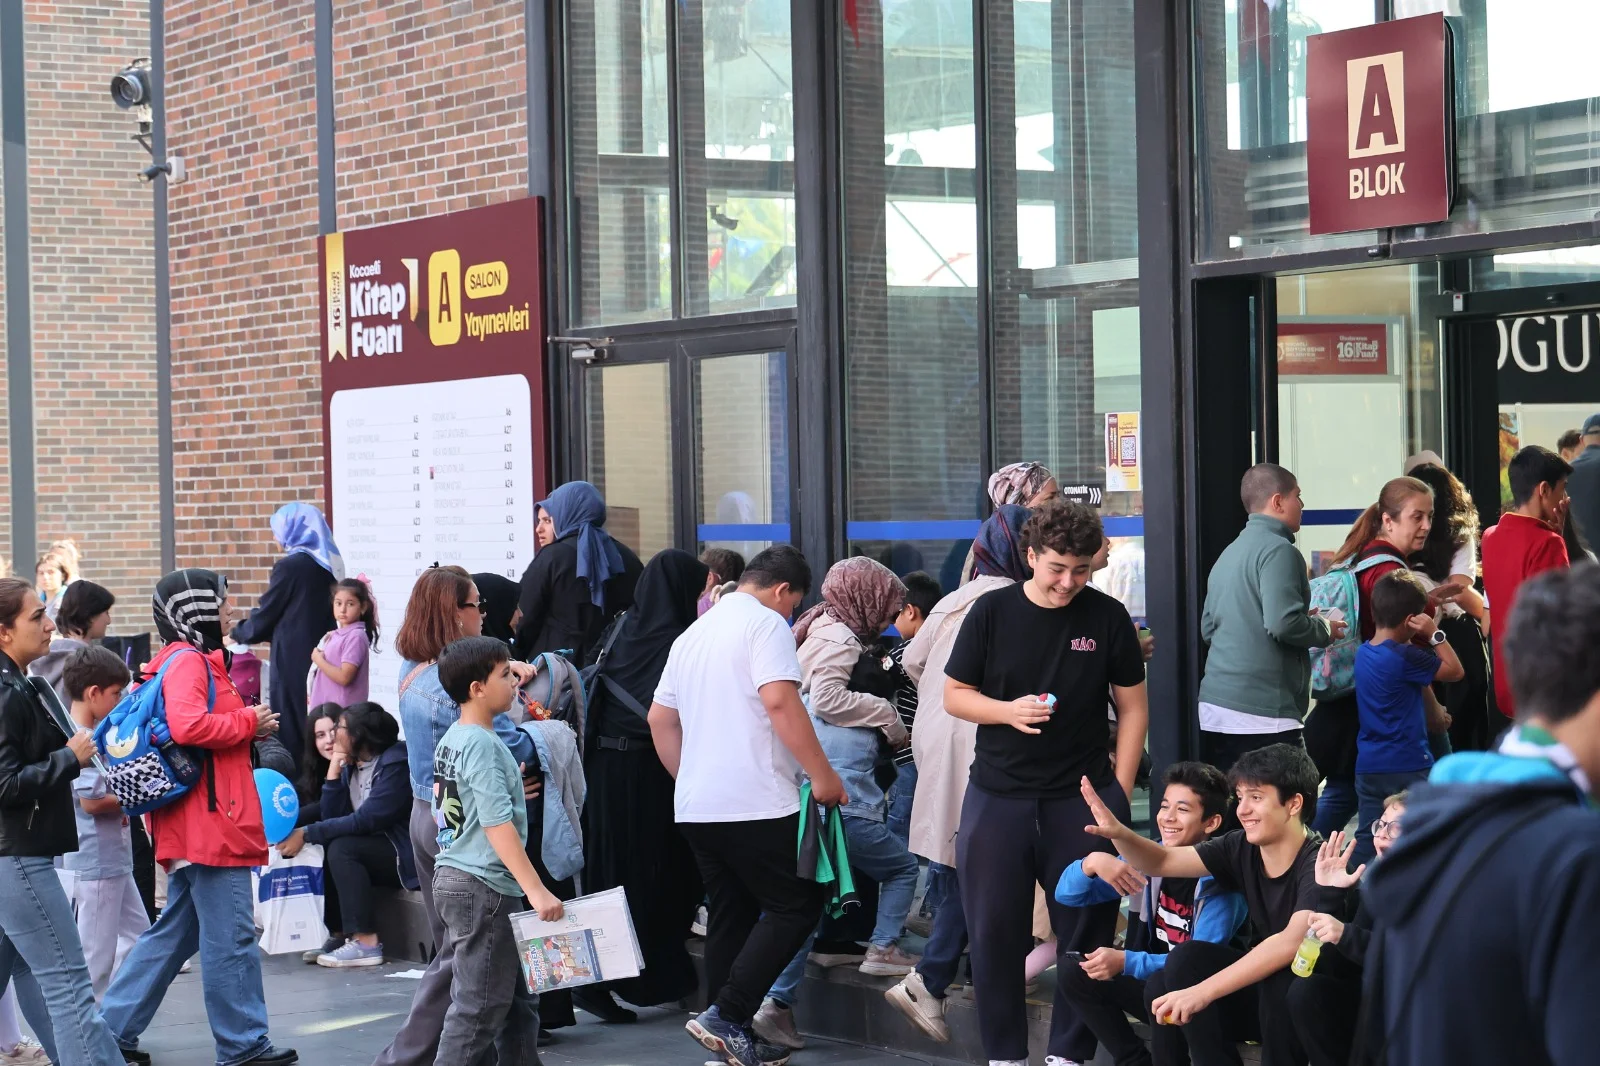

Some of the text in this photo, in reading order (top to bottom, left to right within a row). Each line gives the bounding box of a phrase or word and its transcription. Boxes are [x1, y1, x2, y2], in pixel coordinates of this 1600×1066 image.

[1355, 63, 1399, 151] A
[1349, 163, 1405, 200] BLOK
[350, 260, 381, 279] Kocaeli
[470, 270, 501, 289] SALON
[350, 280, 406, 320] Kitap
[438, 271, 451, 324] A
[351, 322, 403, 358] Fuarı
[465, 302, 529, 342] Yayınevleri
[1337, 341, 1354, 358] 16
[1064, 484, 1088, 495] OTOMATİK
[146, 777, 162, 789] SONI
